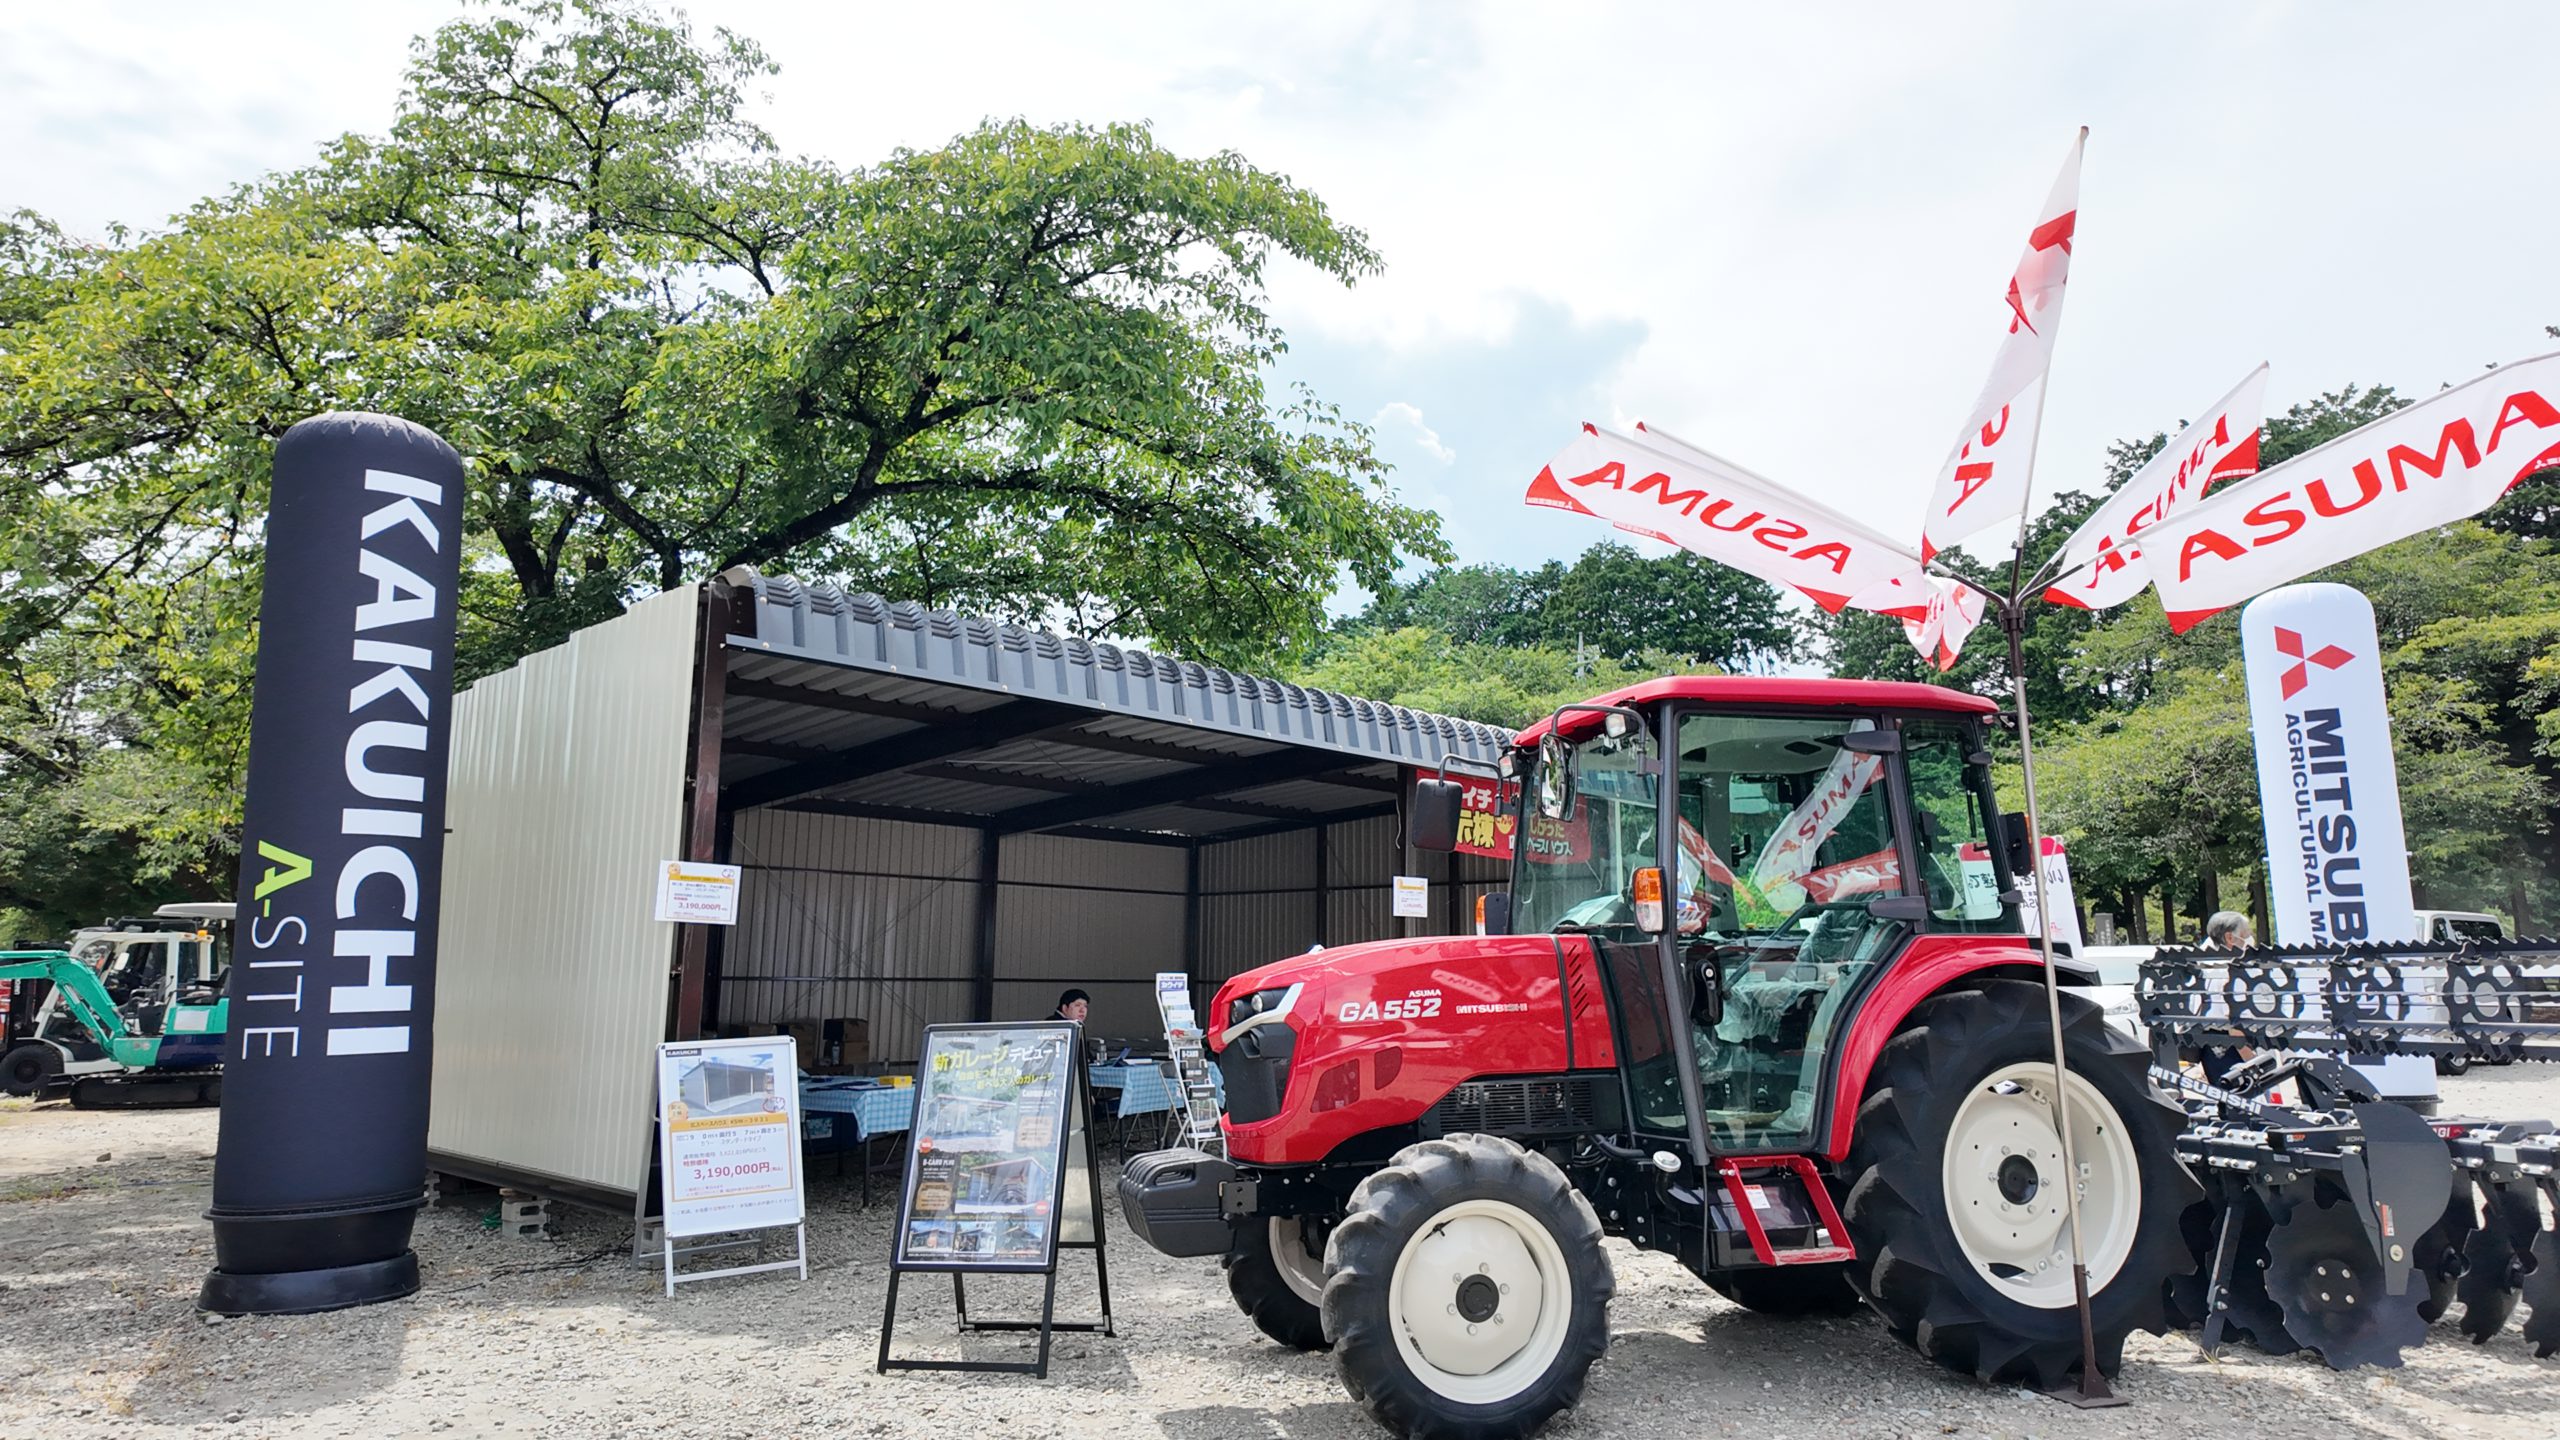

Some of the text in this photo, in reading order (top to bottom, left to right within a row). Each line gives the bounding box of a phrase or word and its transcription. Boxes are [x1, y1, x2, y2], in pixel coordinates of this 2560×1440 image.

[2179, 391, 2560, 583] ASUMA
[327, 468, 443, 1056] KAKUICHI
[2285, 713, 2322, 903] AGRICULTURAL
[242, 839, 313, 1060] A-SITE
[1338, 998, 1528, 1023] GA552 MITSUBISHI
[1408, 989, 1442, 998] ASUMA
[933, 1046, 1009, 1072] 新ガレージ
[2147, 1064, 2262, 1115] MITSUBISHI
[694, 1161, 770, 1181] 3,190,000円
